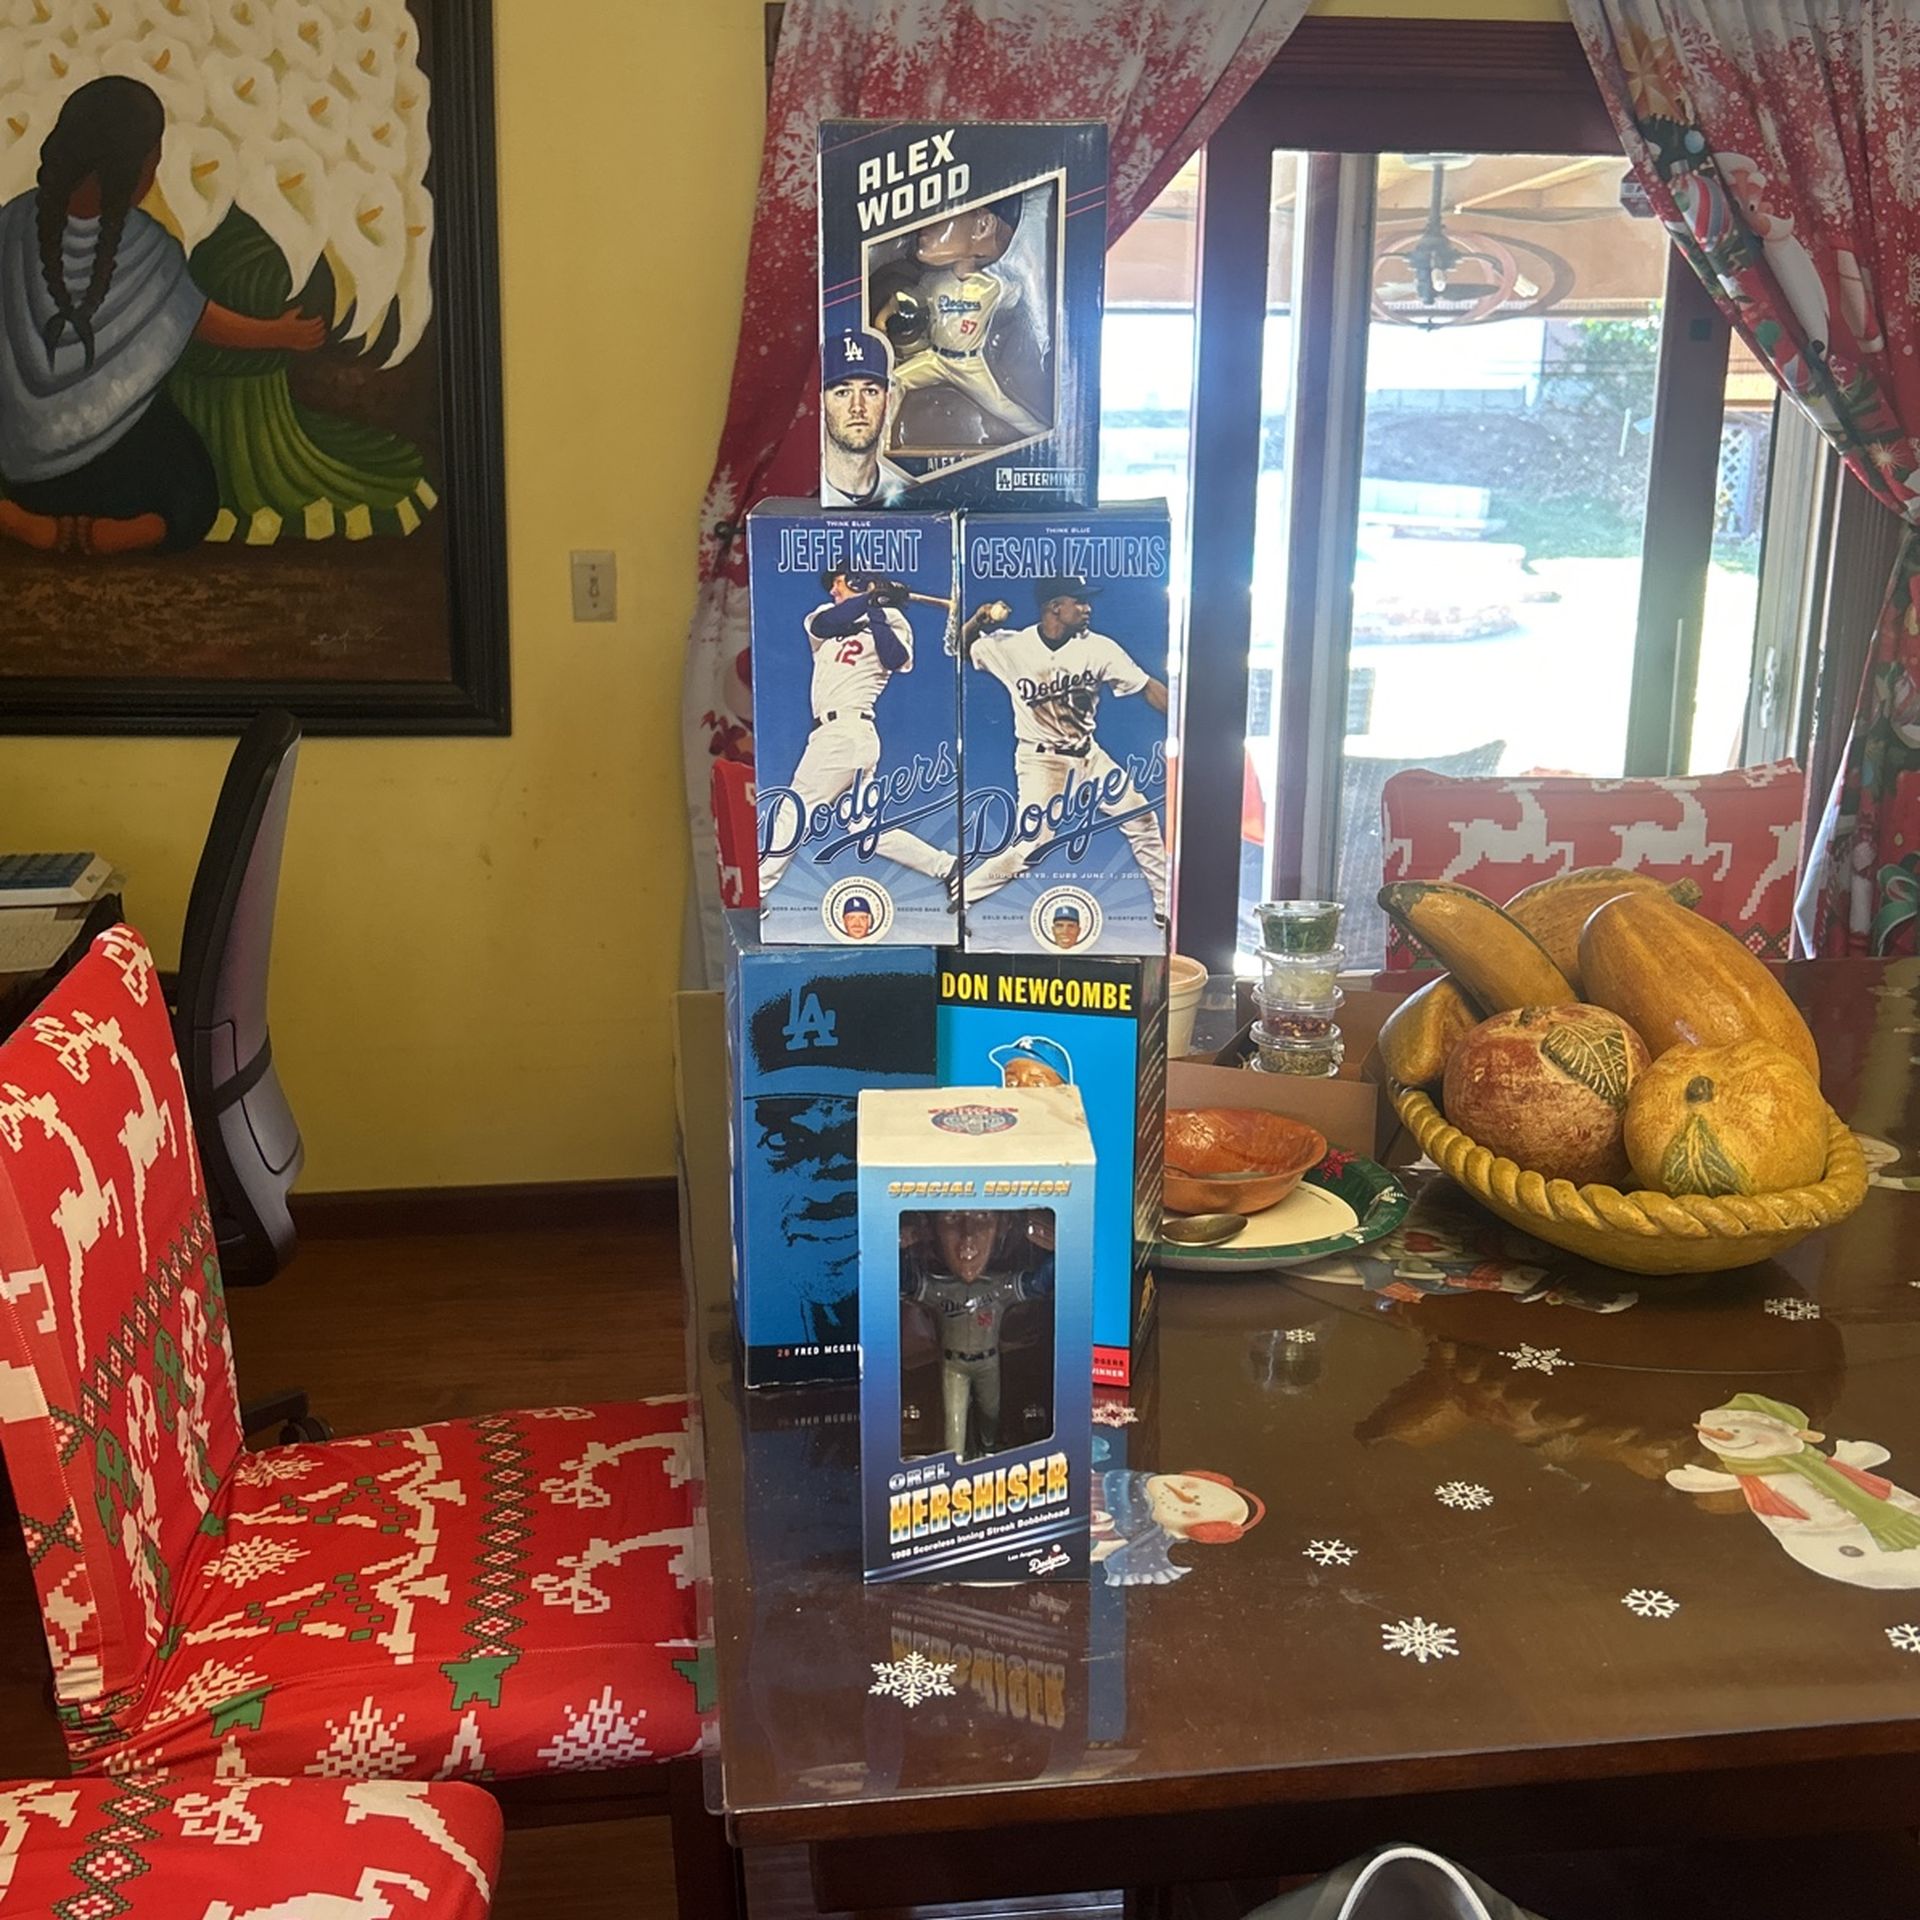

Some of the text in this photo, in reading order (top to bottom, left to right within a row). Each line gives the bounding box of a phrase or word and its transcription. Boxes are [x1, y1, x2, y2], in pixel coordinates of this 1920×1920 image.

[859, 128, 955, 195] ALEX
[857, 163, 970, 232] WOOD
[961, 319, 978, 335] 57
[843, 337, 864, 361] LA
[1014, 473, 1086, 486] DETERMINED
[778, 529, 922, 572] JEFF KENT
[971, 536, 1166, 579] CESAR IZTURIS
[834, 640, 863, 666] 12
[757, 741, 959, 865] Dodgers
[963, 741, 1167, 866] Dodgers
[942, 972, 1132, 1011] DON NEWCOMBE
[783, 986, 838, 1050] LA
[888, 1180, 1071, 1197] SPECIAL EDITION
[795, 1347, 819, 1356] FRED
[824, 1344, 860, 1354] MCGRI
[889, 1463, 950, 1490] OREL
[890, 1452, 1068, 1545] HERSHISER
[891, 1506, 1070, 1560] 1988 Scoreless Inning Streak Bobblehead
[1029, 1552, 1070, 1575] Dodgers
